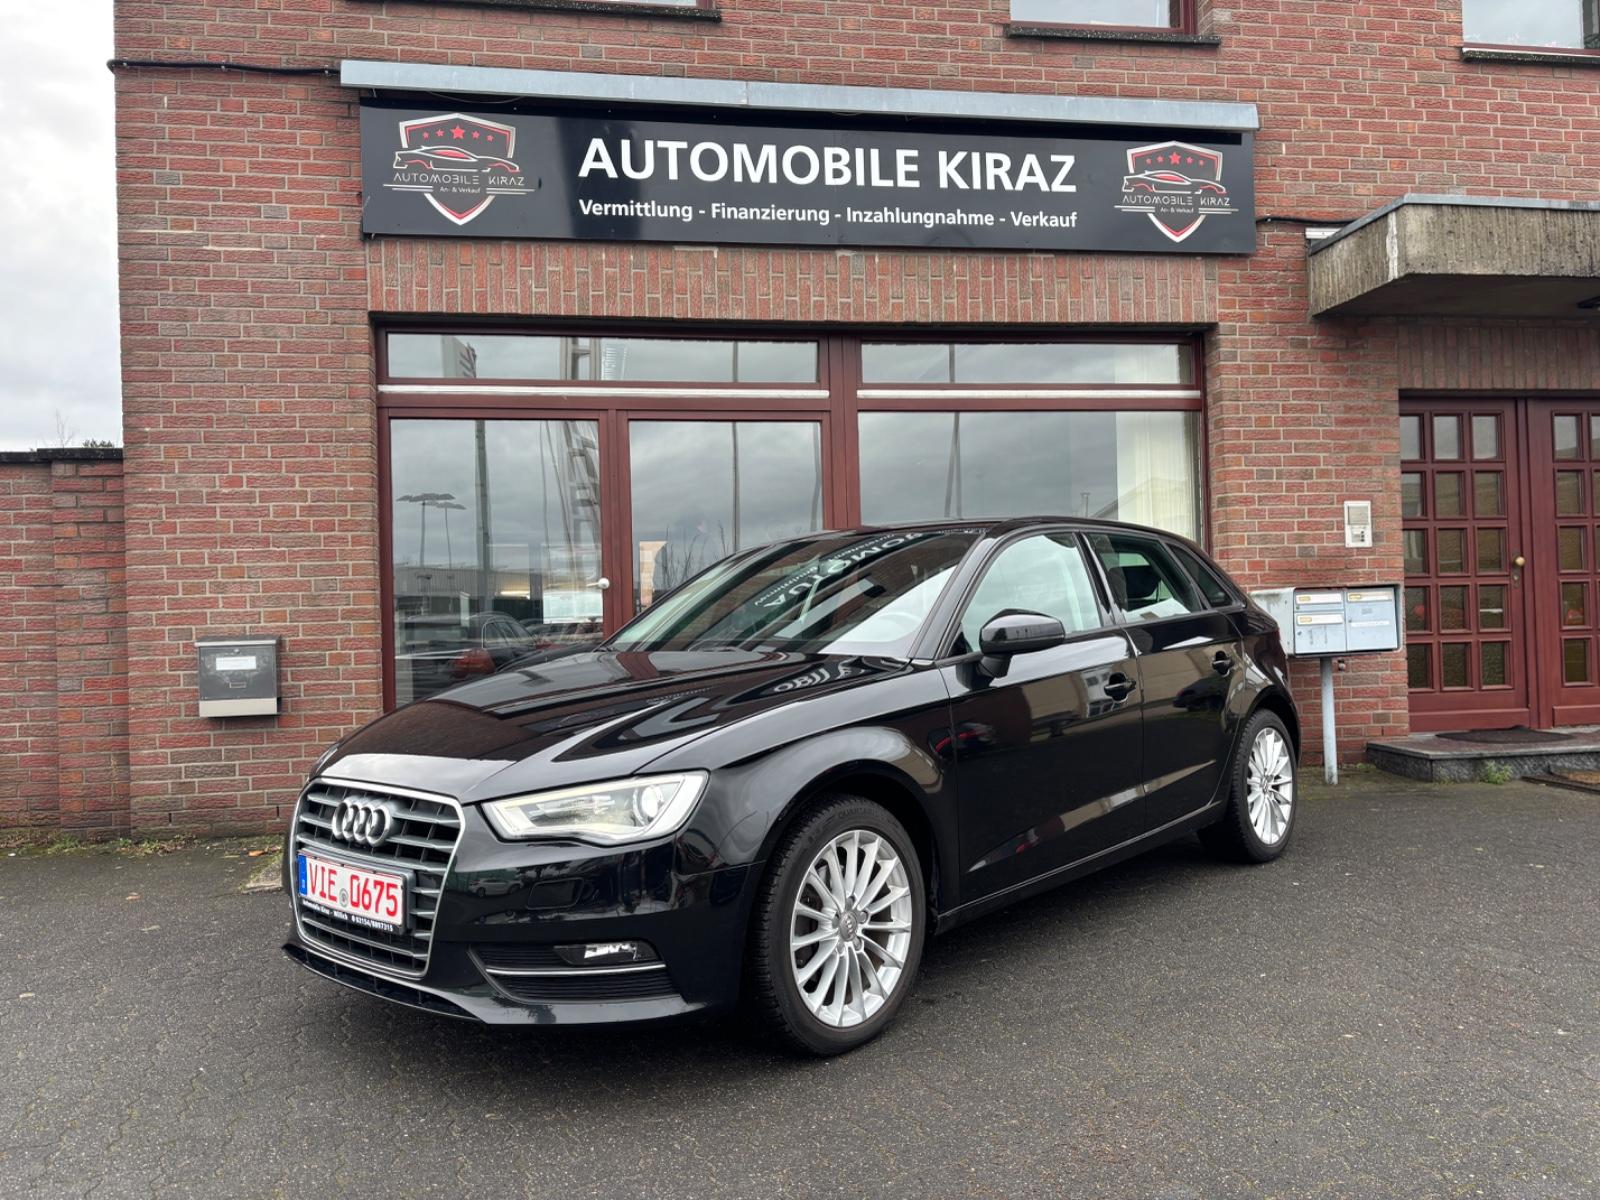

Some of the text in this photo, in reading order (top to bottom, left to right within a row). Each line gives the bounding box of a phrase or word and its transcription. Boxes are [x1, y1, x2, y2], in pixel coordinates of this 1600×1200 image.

[579, 138, 1077, 193] AUTOMOBILE KIRAZ
[393, 172, 525, 186] AUTOMOBILE KIRAZ
[459, 186, 481, 194] Verkauf
[1122, 195, 1231, 206] AUTOMOBILE KIRAZ
[578, 199, 693, 223] Vermittlung
[711, 202, 830, 226] Finanzierung
[846, 206, 995, 229] Inzahlungnahme
[1009, 210, 1078, 228] Verkauf
[309, 862, 398, 917] VIE 0675
